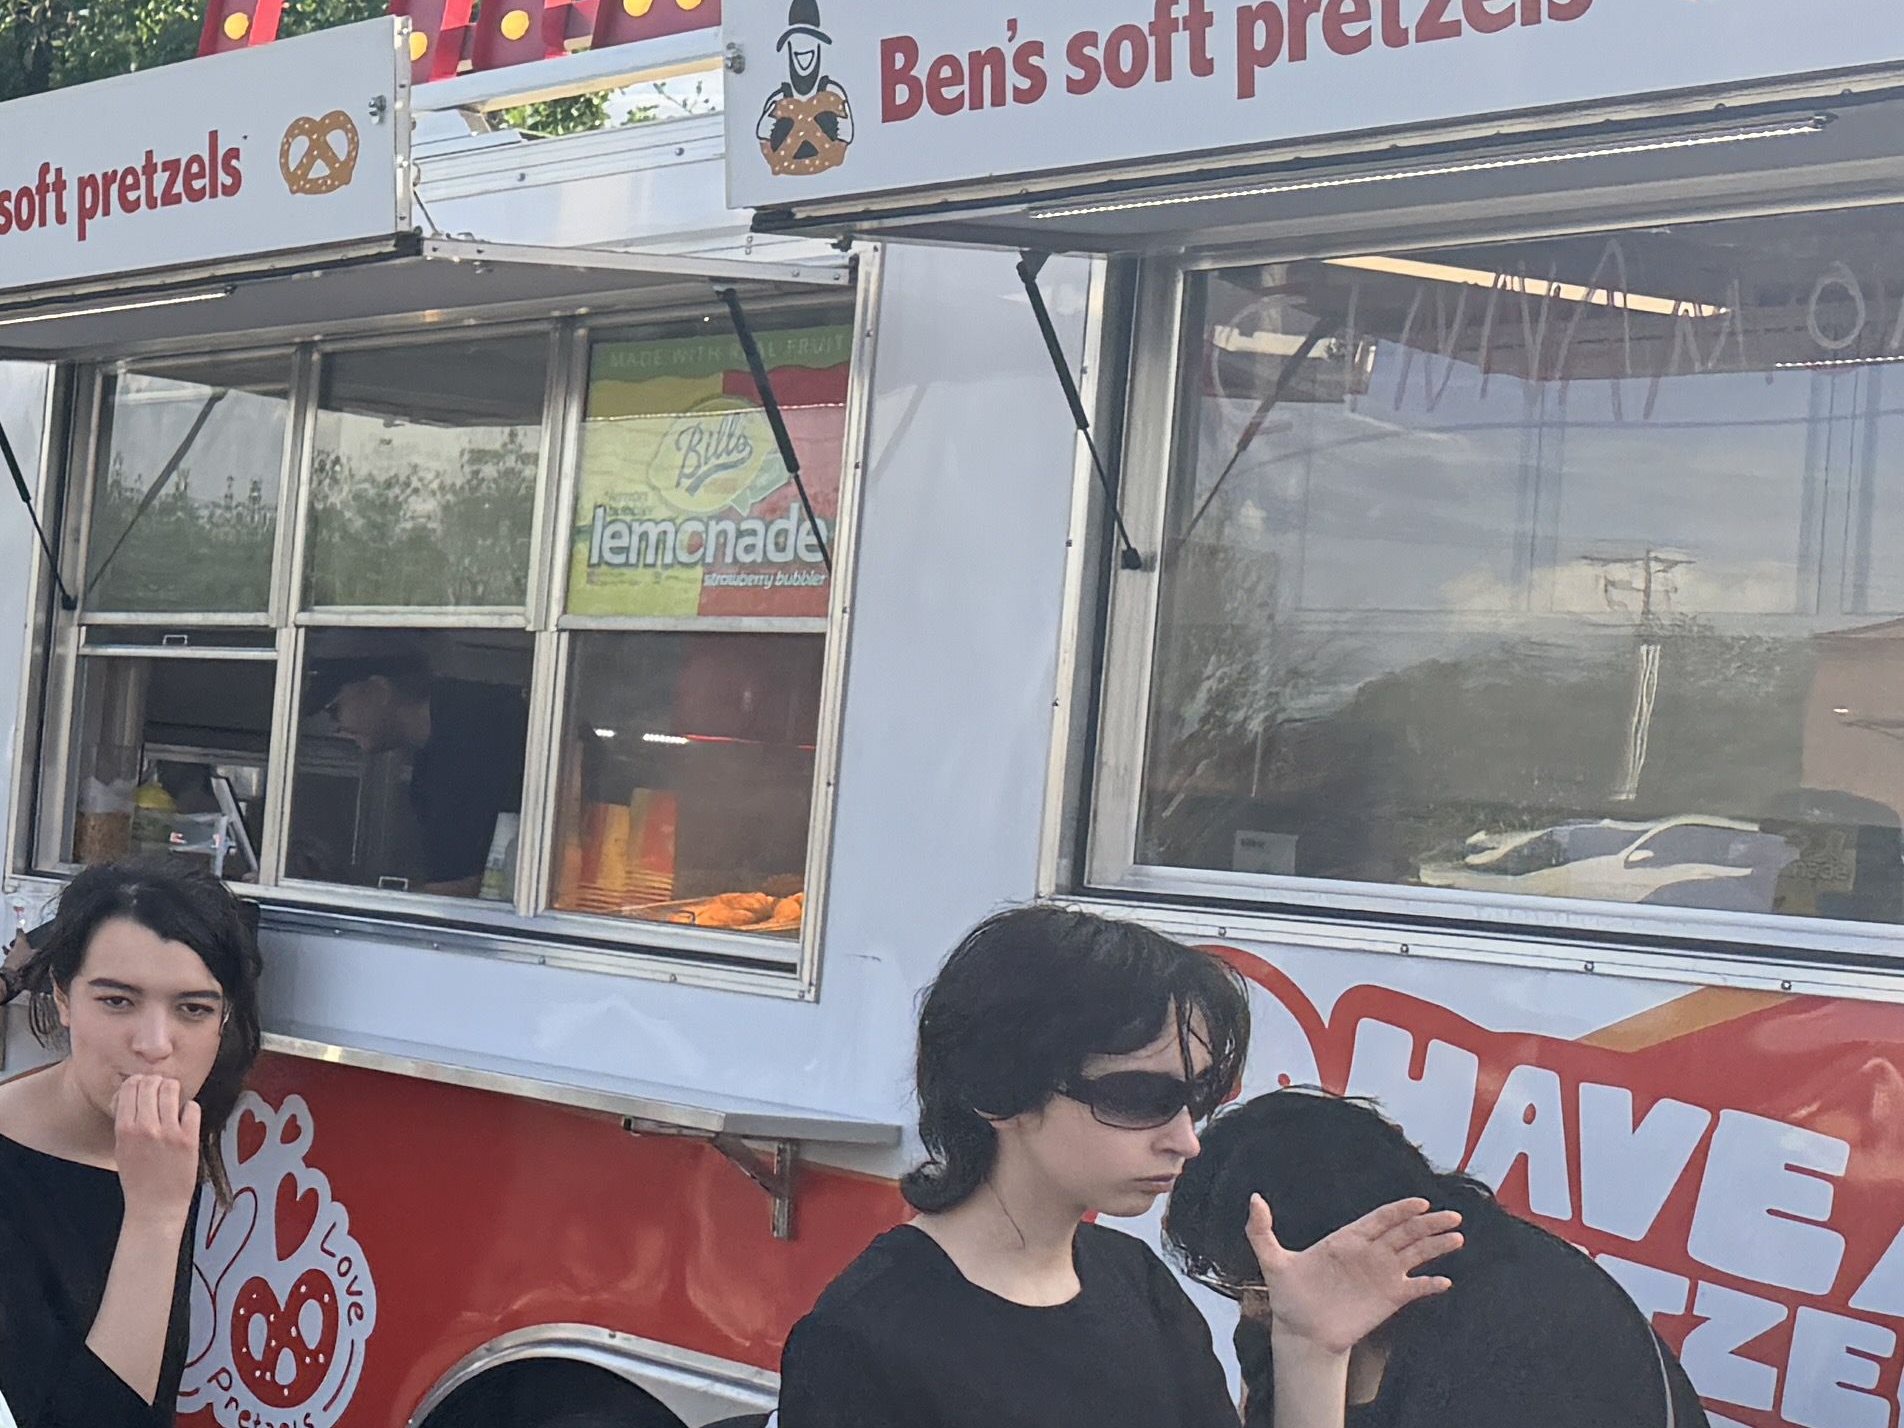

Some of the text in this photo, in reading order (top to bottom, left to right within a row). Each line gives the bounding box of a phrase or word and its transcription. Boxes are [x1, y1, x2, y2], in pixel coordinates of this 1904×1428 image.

[879, 18, 1048, 125] Ben's
[77, 129, 243, 242] pretzels
[729, 340, 776, 363] RAL
[587, 502, 830, 568] lemonade
[1342, 1017, 1851, 1296] HAVE
[319, 1221, 365, 1327] Love
